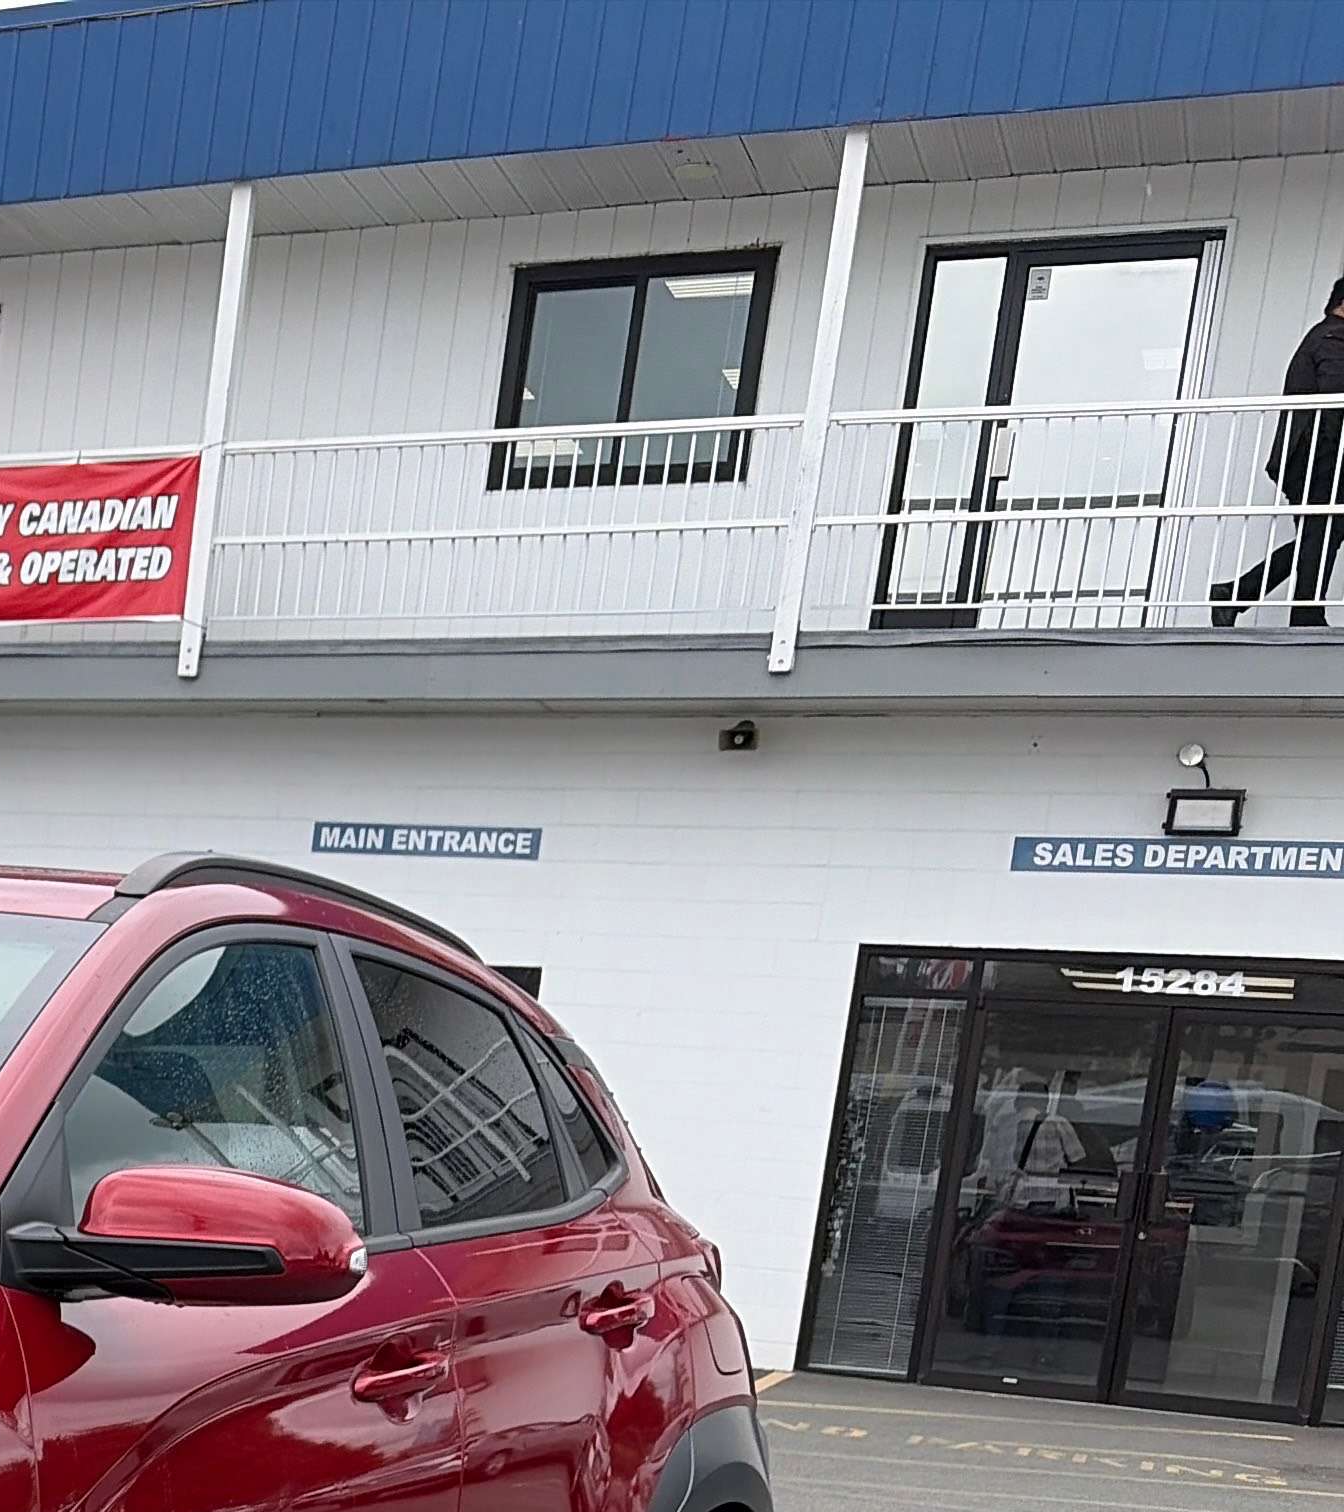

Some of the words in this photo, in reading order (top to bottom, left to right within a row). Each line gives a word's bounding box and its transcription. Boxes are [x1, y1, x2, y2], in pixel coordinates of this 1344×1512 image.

[18, 494, 180, 537] CANADIAN
[19, 546, 173, 586] OPERATED
[319, 826, 385, 849] MAIN
[391, 828, 533, 855] ENTRANCE
[1032, 842, 1134, 868] SALES
[1115, 966, 1246, 996] 15284
